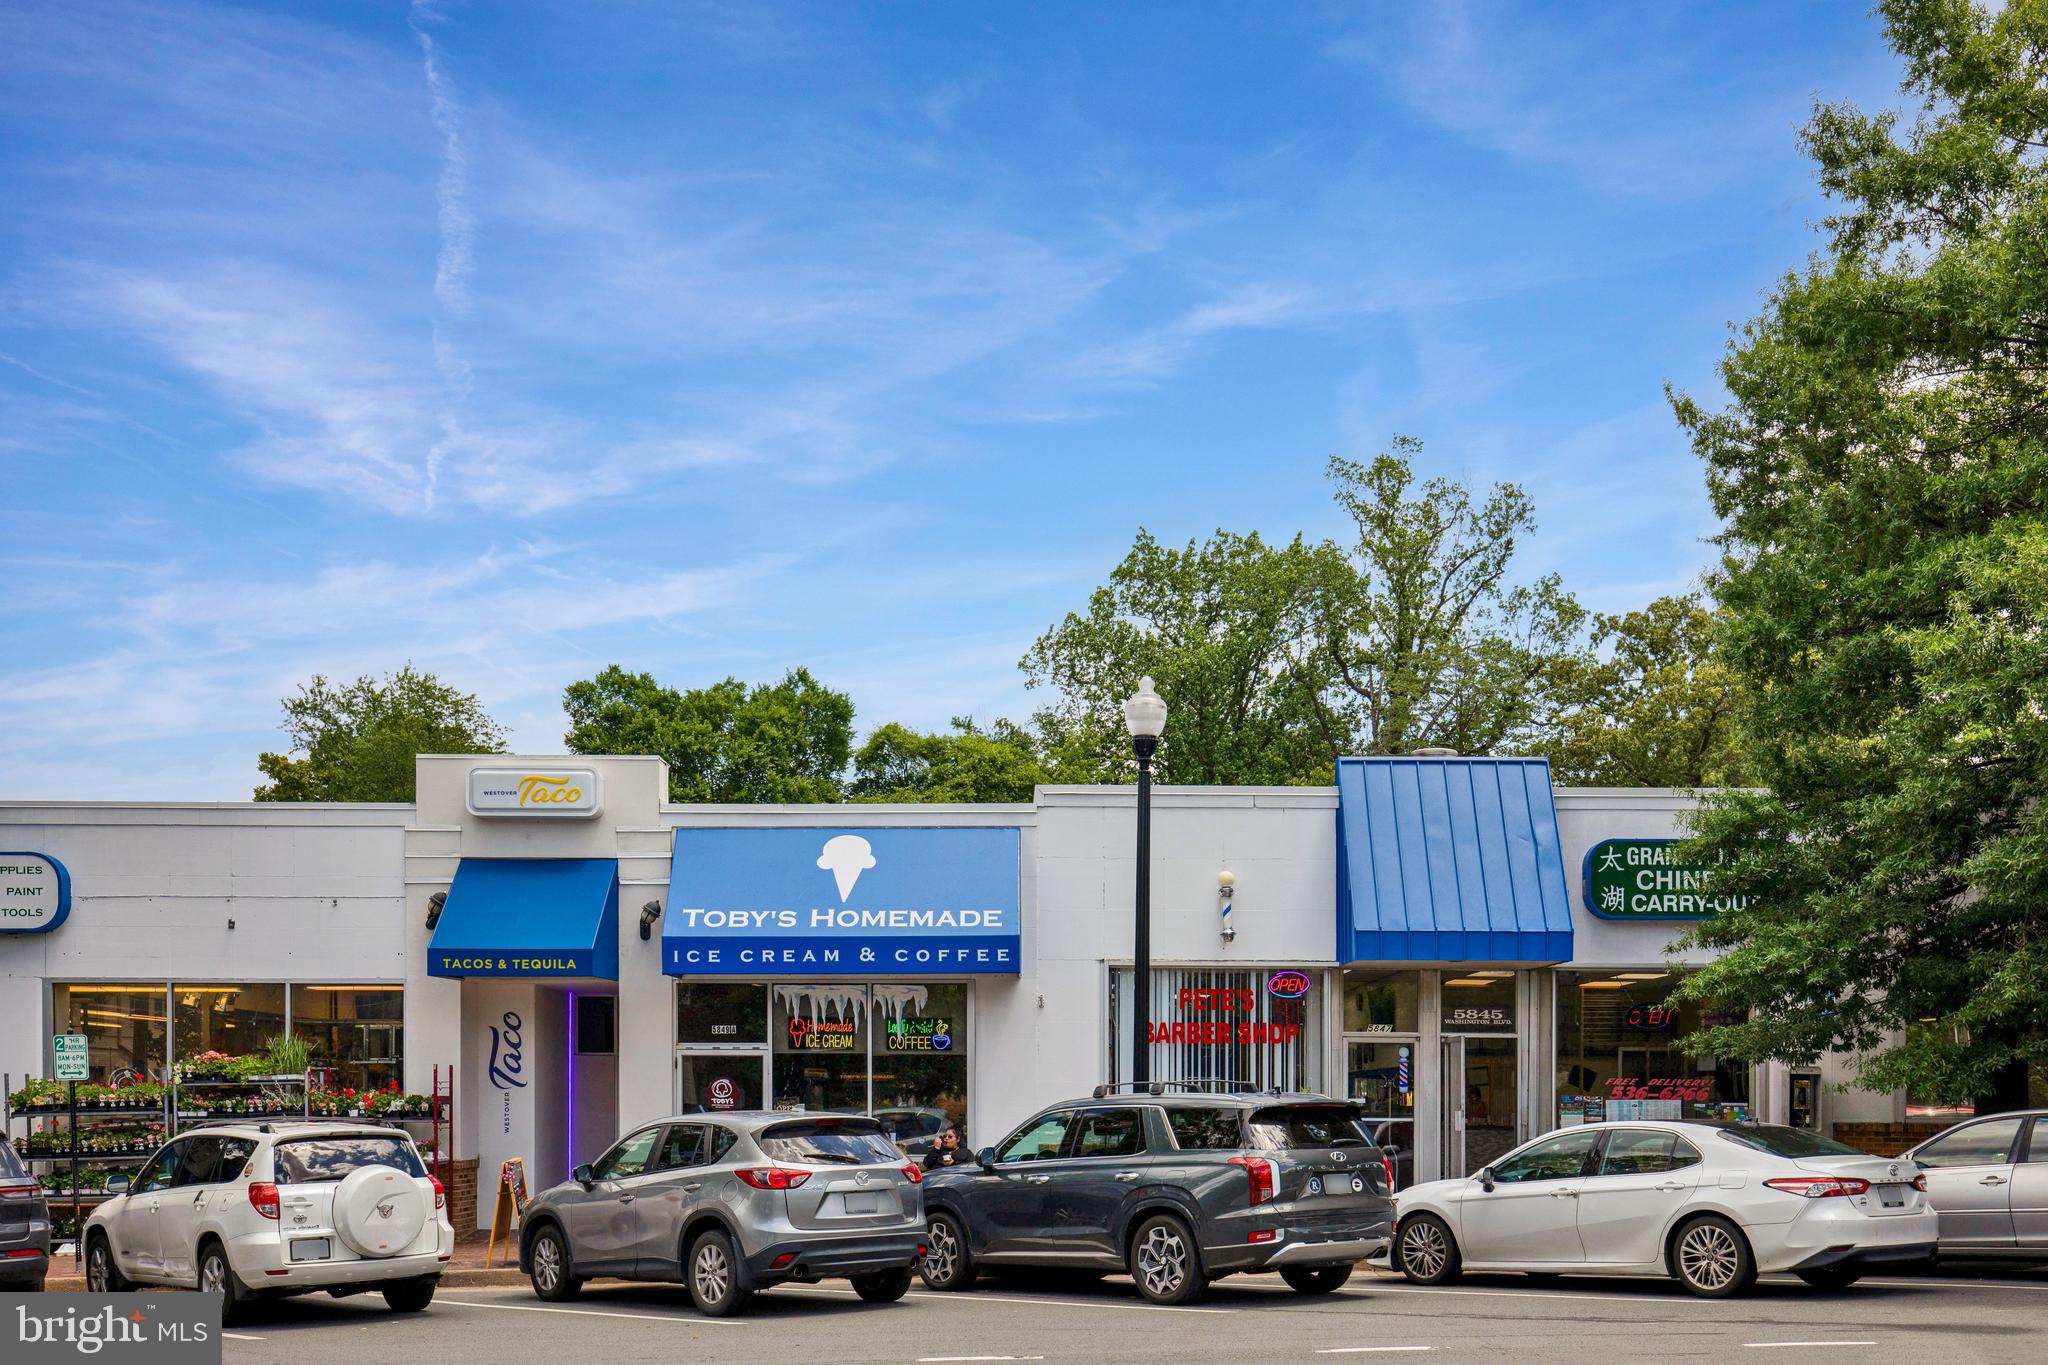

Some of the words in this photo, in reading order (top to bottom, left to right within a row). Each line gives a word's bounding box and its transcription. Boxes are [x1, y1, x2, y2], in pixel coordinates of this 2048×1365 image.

[518, 775, 582, 808] Taco
[6, 887, 44, 896] PAINT
[1631, 894, 1761, 913] CARRY-OU
[1, 908, 44, 917] TOOLS
[683, 908, 797, 928] TOBY'S
[810, 908, 1003, 928] HOMEMADE
[673, 950, 721, 963] ICE
[740, 950, 840, 963] CREAM
[859, 947, 875, 962] &
[895, 949, 1010, 962] COFFEE
[442, 958, 493, 969] TACOS
[497, 959, 507, 969] &
[512, 959, 576, 969] TEQUILA
[1270, 978, 1305, 991] OPEN
[1179, 988, 1255, 1011] PETE'S
[1454, 1009, 1503, 1019] 5845
[1238, 1022, 1299, 1044] SHOP
[1367, 1024, 1392, 1032] 5847
[55, 1038, 64, 1051] 2
[806, 1034, 820, 1047] ICE
[822, 1034, 853, 1047] CREAM
[889, 1035, 932, 1049] COFFEE
[488, 1011, 528, 1090] Taco
[1605, 1078, 1639, 1086] FREE
